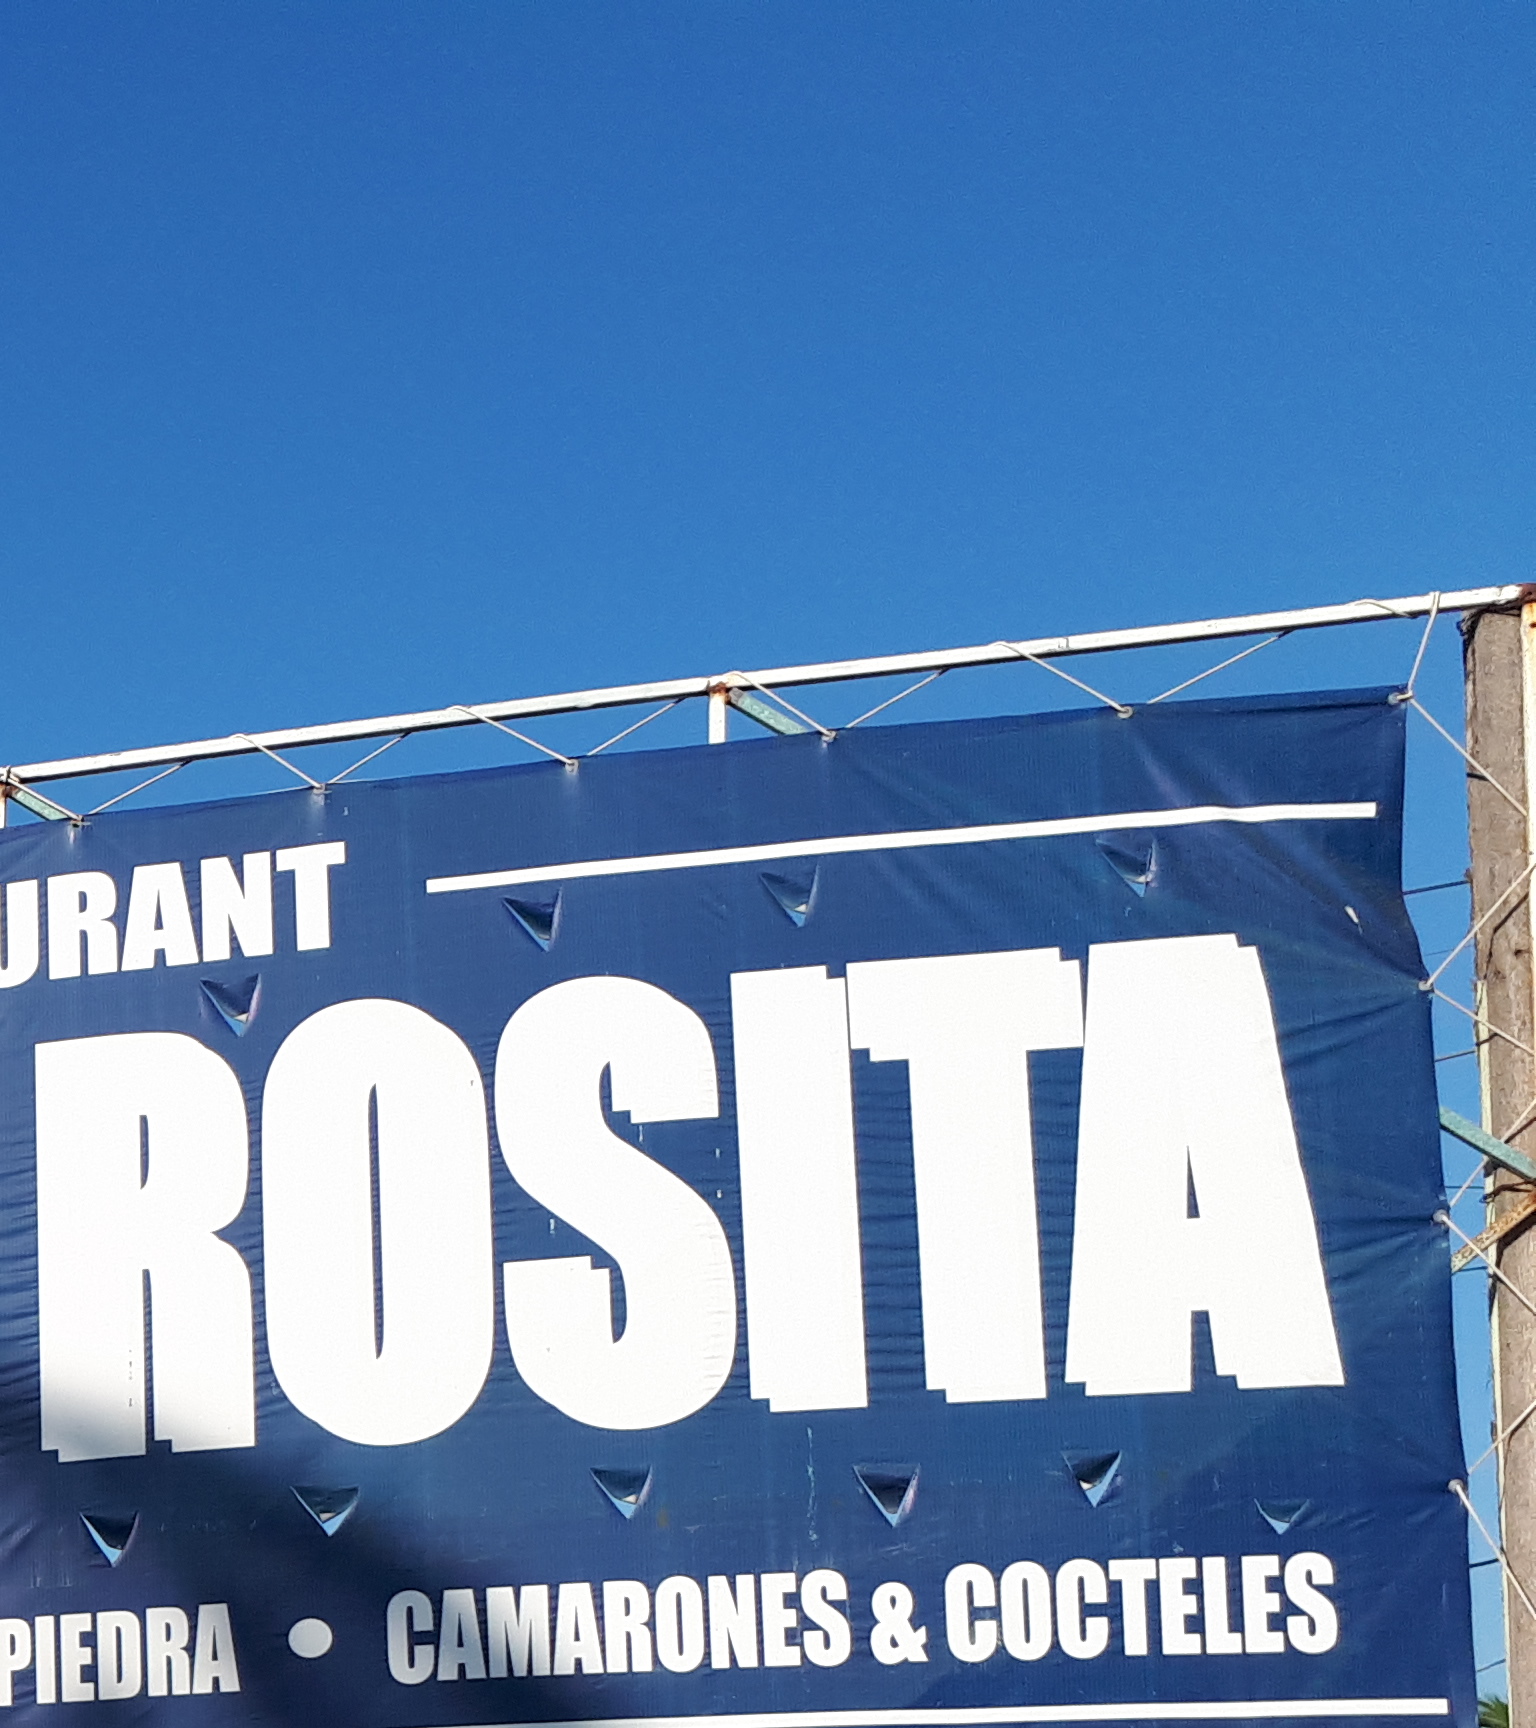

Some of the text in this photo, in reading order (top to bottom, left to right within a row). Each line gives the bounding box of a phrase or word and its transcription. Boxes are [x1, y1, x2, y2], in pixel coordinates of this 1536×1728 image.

[35, 934, 1346, 1463] ROSITA
[388, 1570, 851, 1685] CAMARONES
[870, 1581, 927, 1665] &
[944, 1554, 1338, 1663] COCTELES
